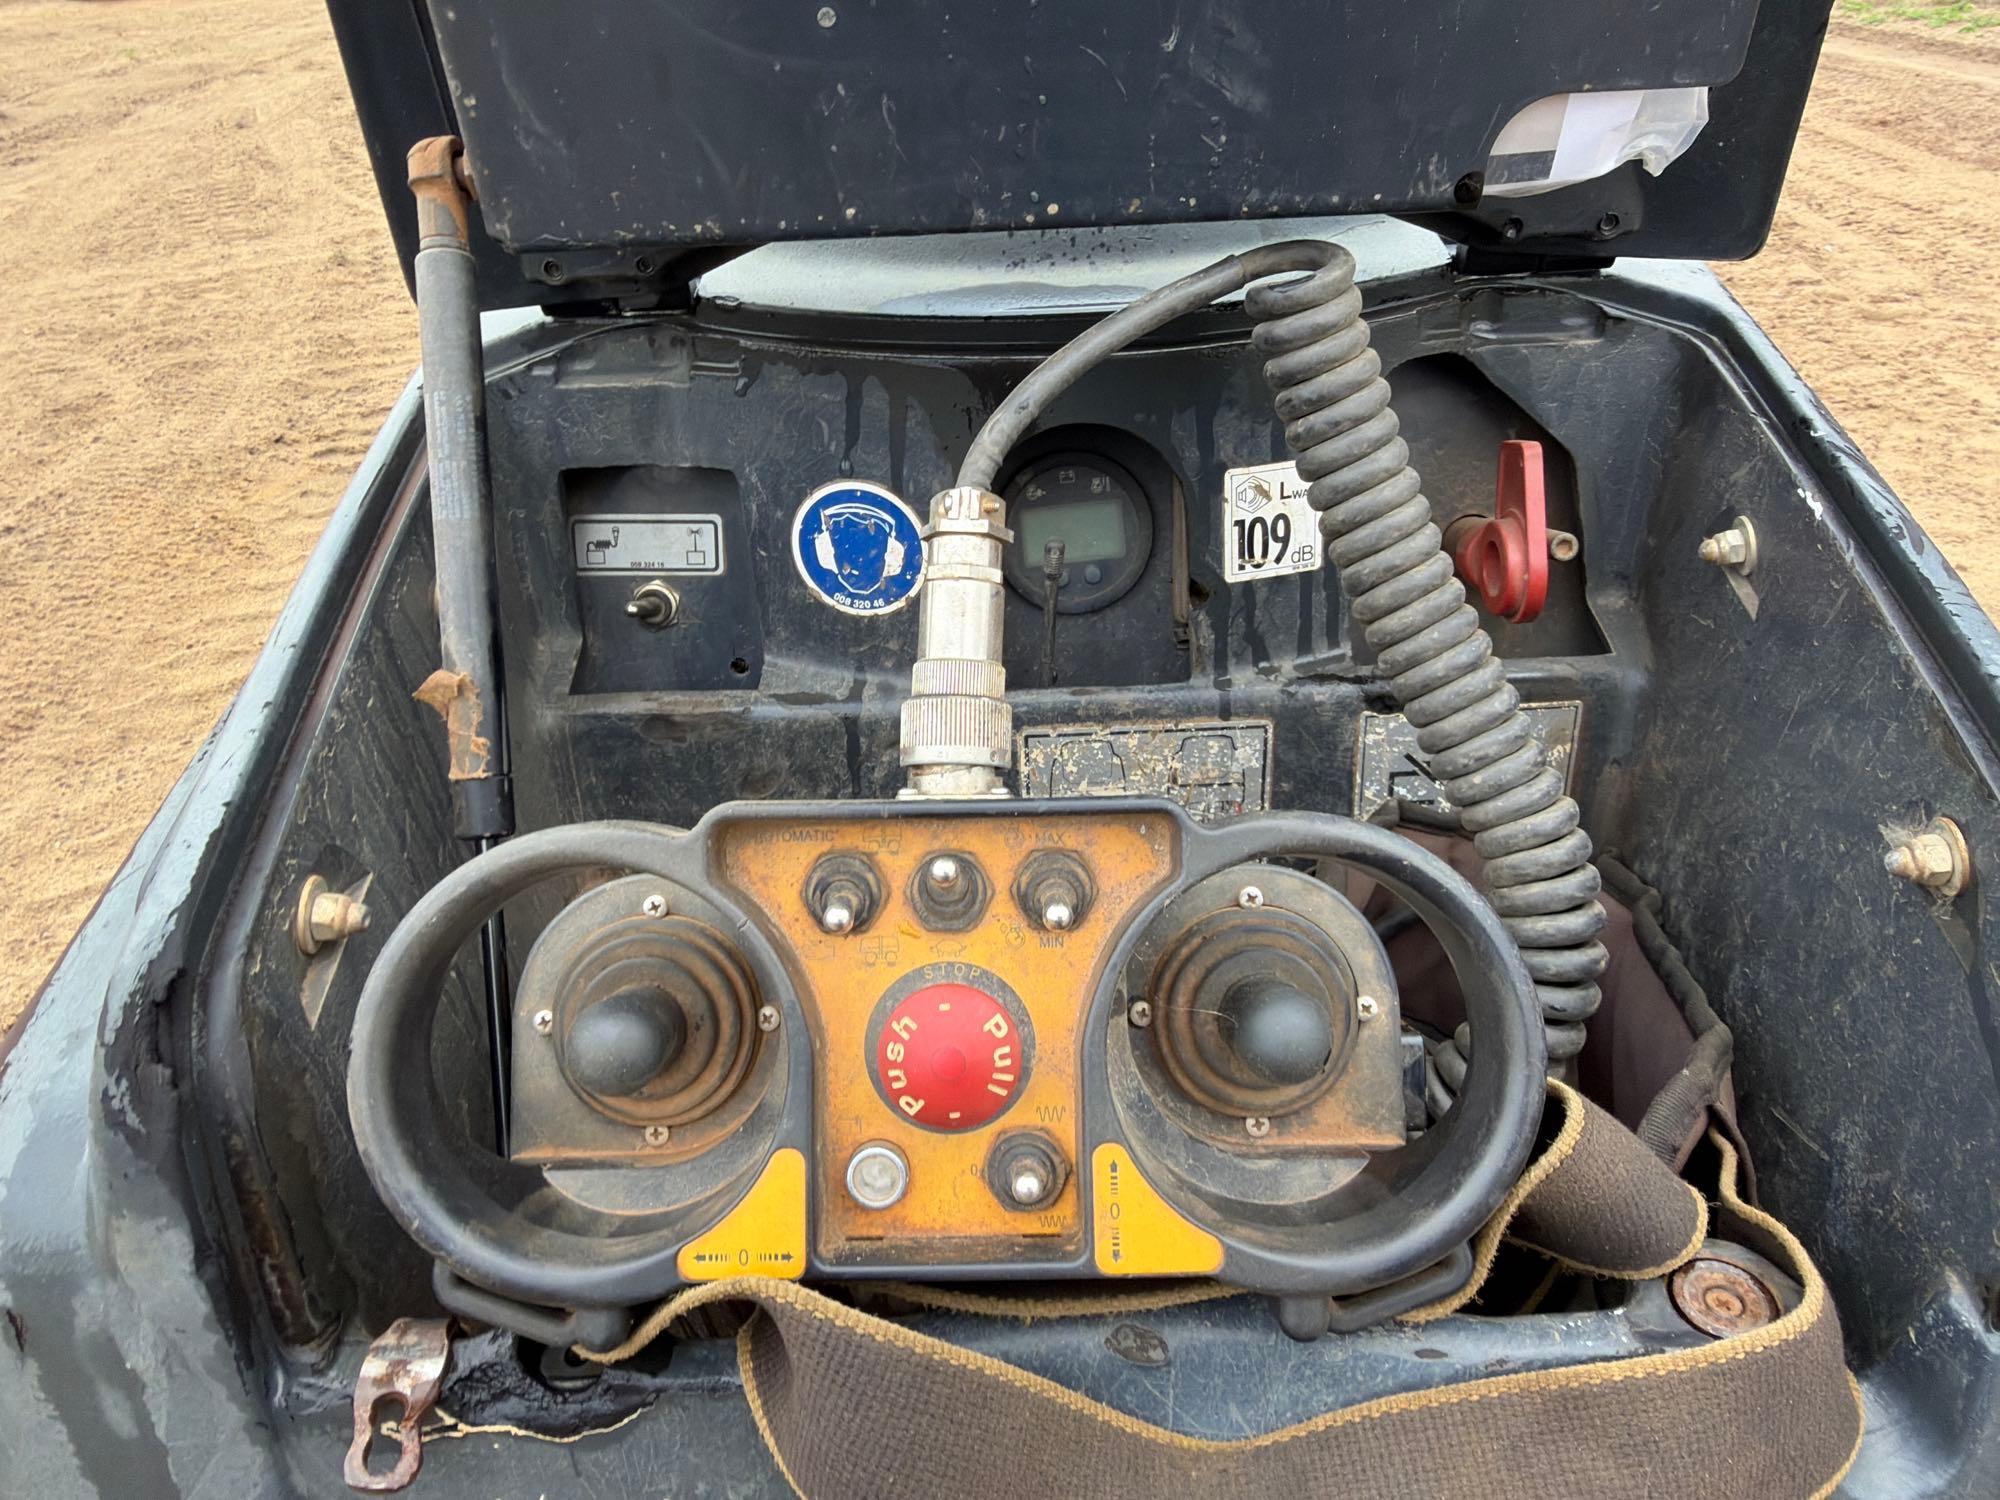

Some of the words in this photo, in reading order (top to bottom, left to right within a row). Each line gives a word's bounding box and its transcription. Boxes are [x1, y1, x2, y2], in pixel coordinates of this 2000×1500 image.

[1233, 512, 1292, 571] 109
[1291, 544, 1314, 563] dB
[833, 592, 851, 606] 008
[852, 599, 871, 609] 320
[873, 598, 885, 608] 46
[1039, 934, 1065, 949] MIN
[923, 962, 981, 980] STOP
[982, 1012, 1015, 1097] Pull
[886, 1014, 926, 1117] Push
